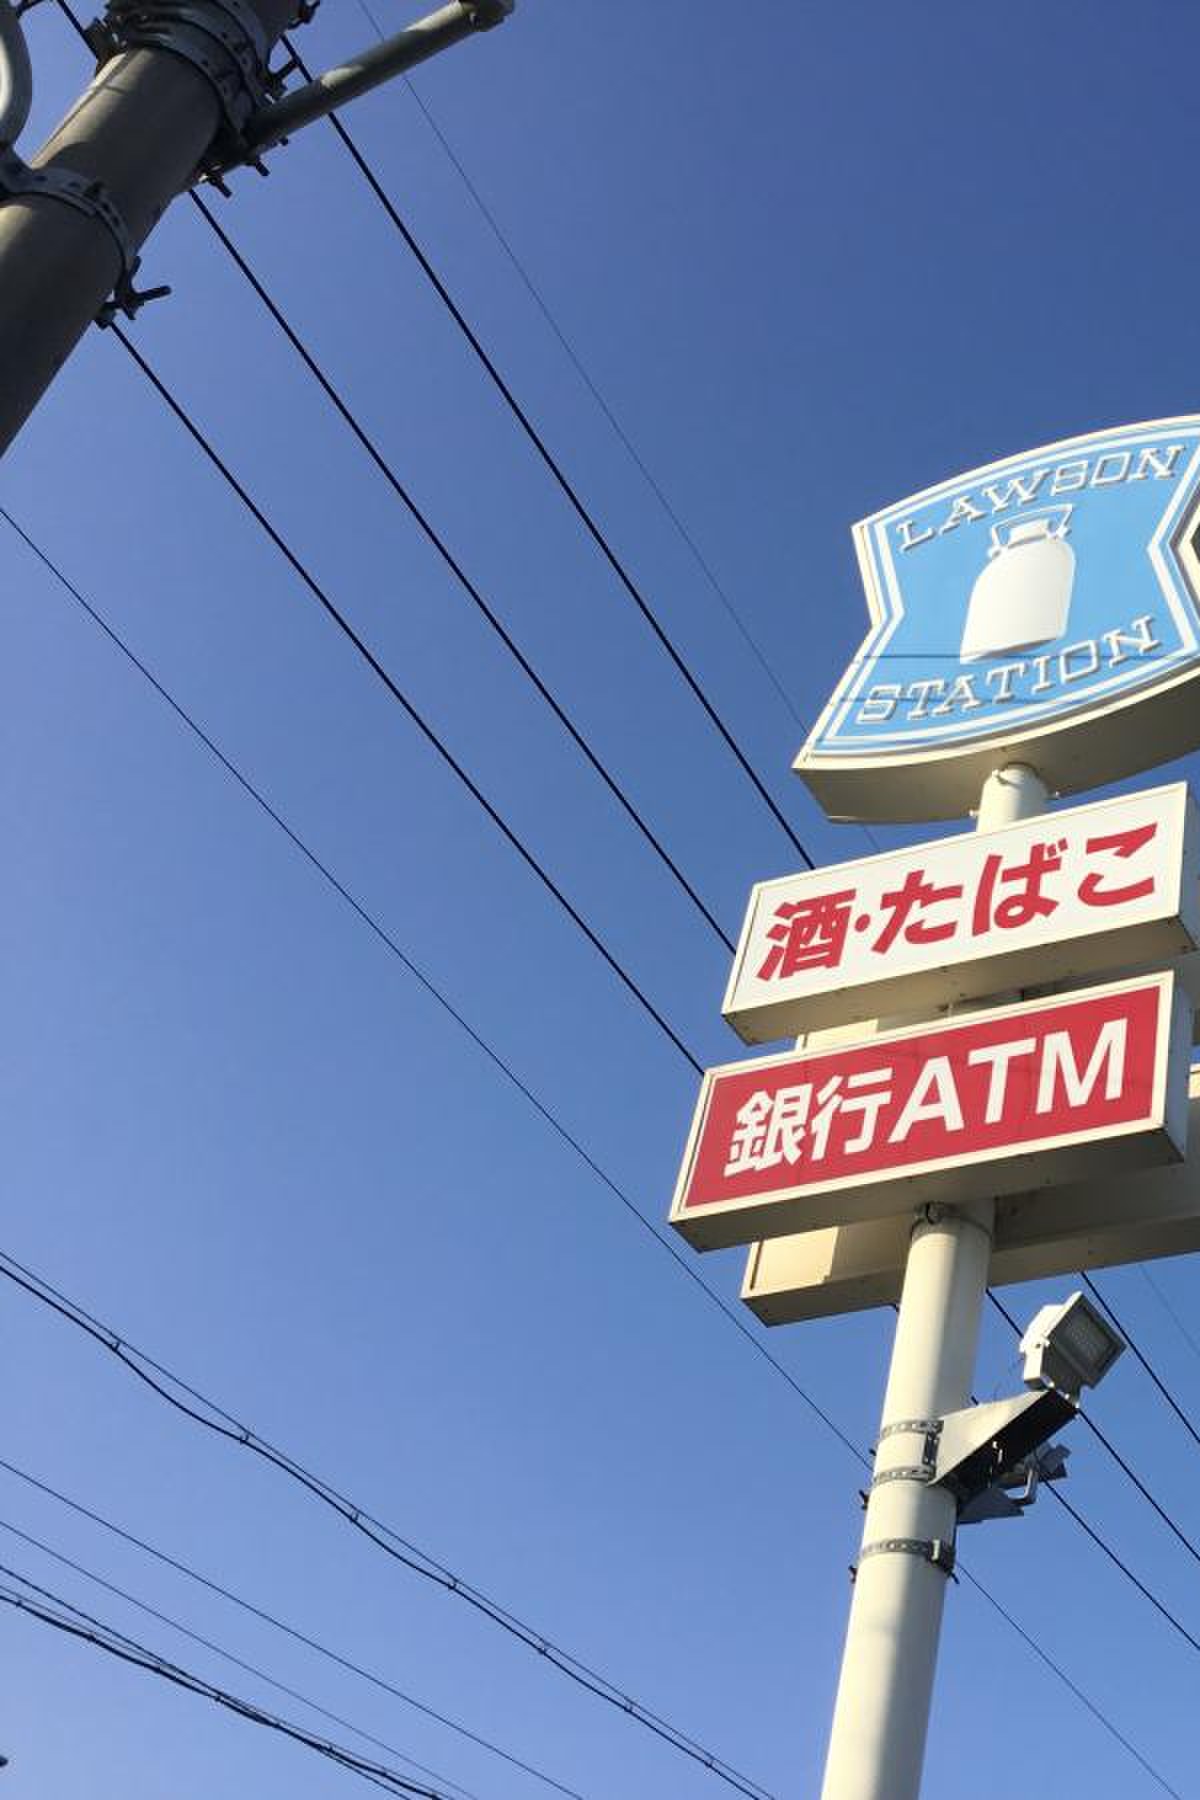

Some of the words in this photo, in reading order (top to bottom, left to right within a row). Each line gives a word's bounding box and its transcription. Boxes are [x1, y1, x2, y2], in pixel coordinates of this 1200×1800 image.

[896, 445, 1186, 552] LAWSON
[855, 615, 1162, 724] STATION
[723, 1018, 1128, 1177] 銀行ATM
